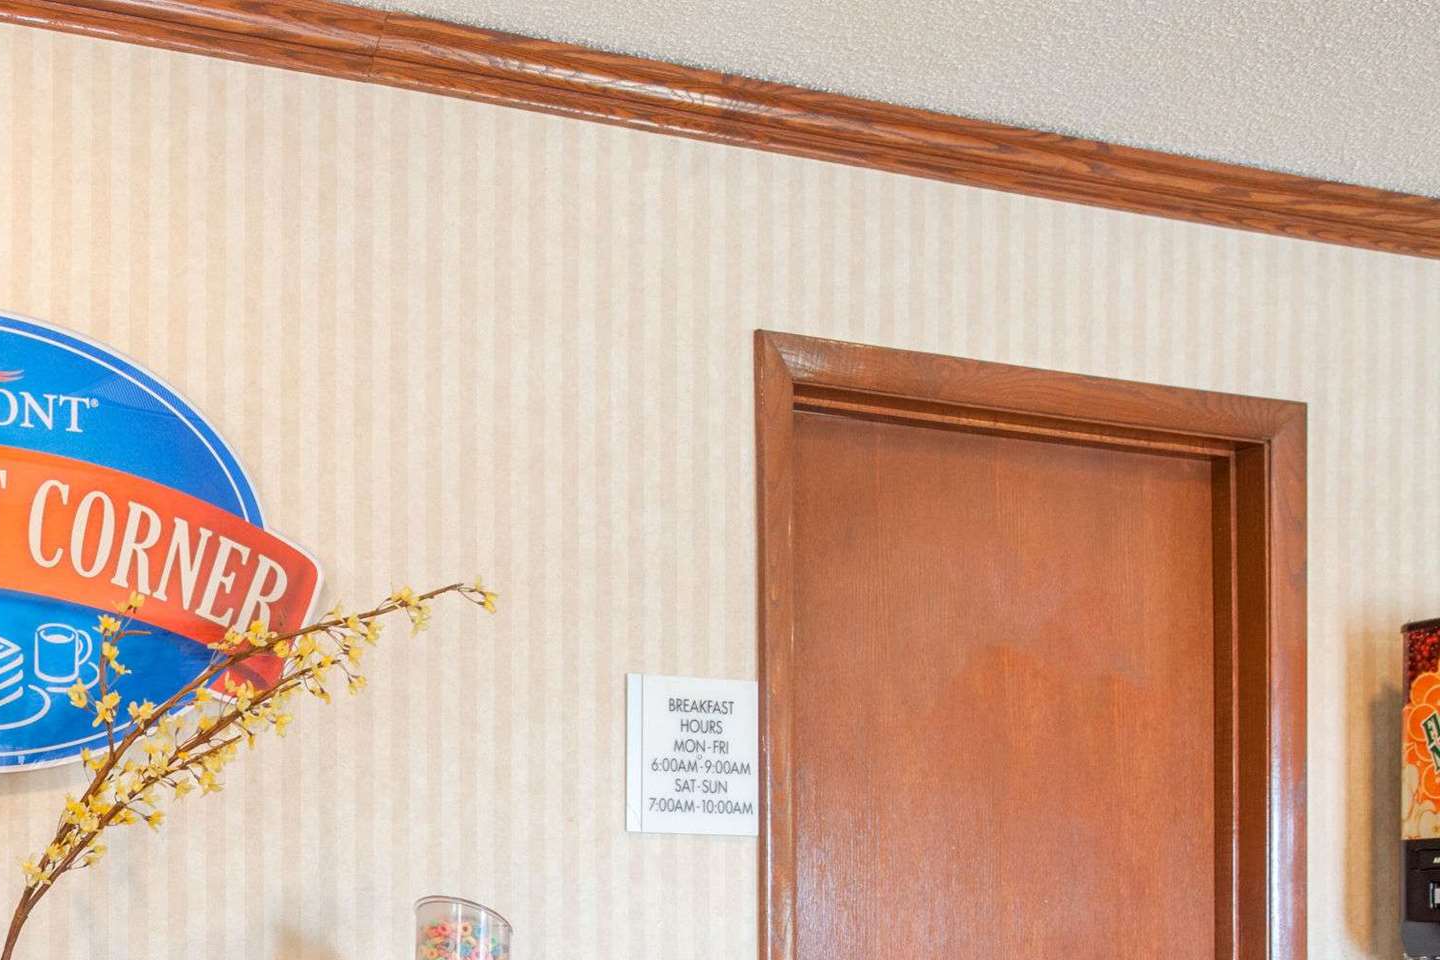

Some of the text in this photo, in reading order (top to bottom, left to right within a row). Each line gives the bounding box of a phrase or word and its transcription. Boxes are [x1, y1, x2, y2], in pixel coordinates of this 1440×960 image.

[27, 479, 288, 634] CORNER
[668, 697, 735, 715] BREAKFAST
[680, 719, 724, 735] HOURS
